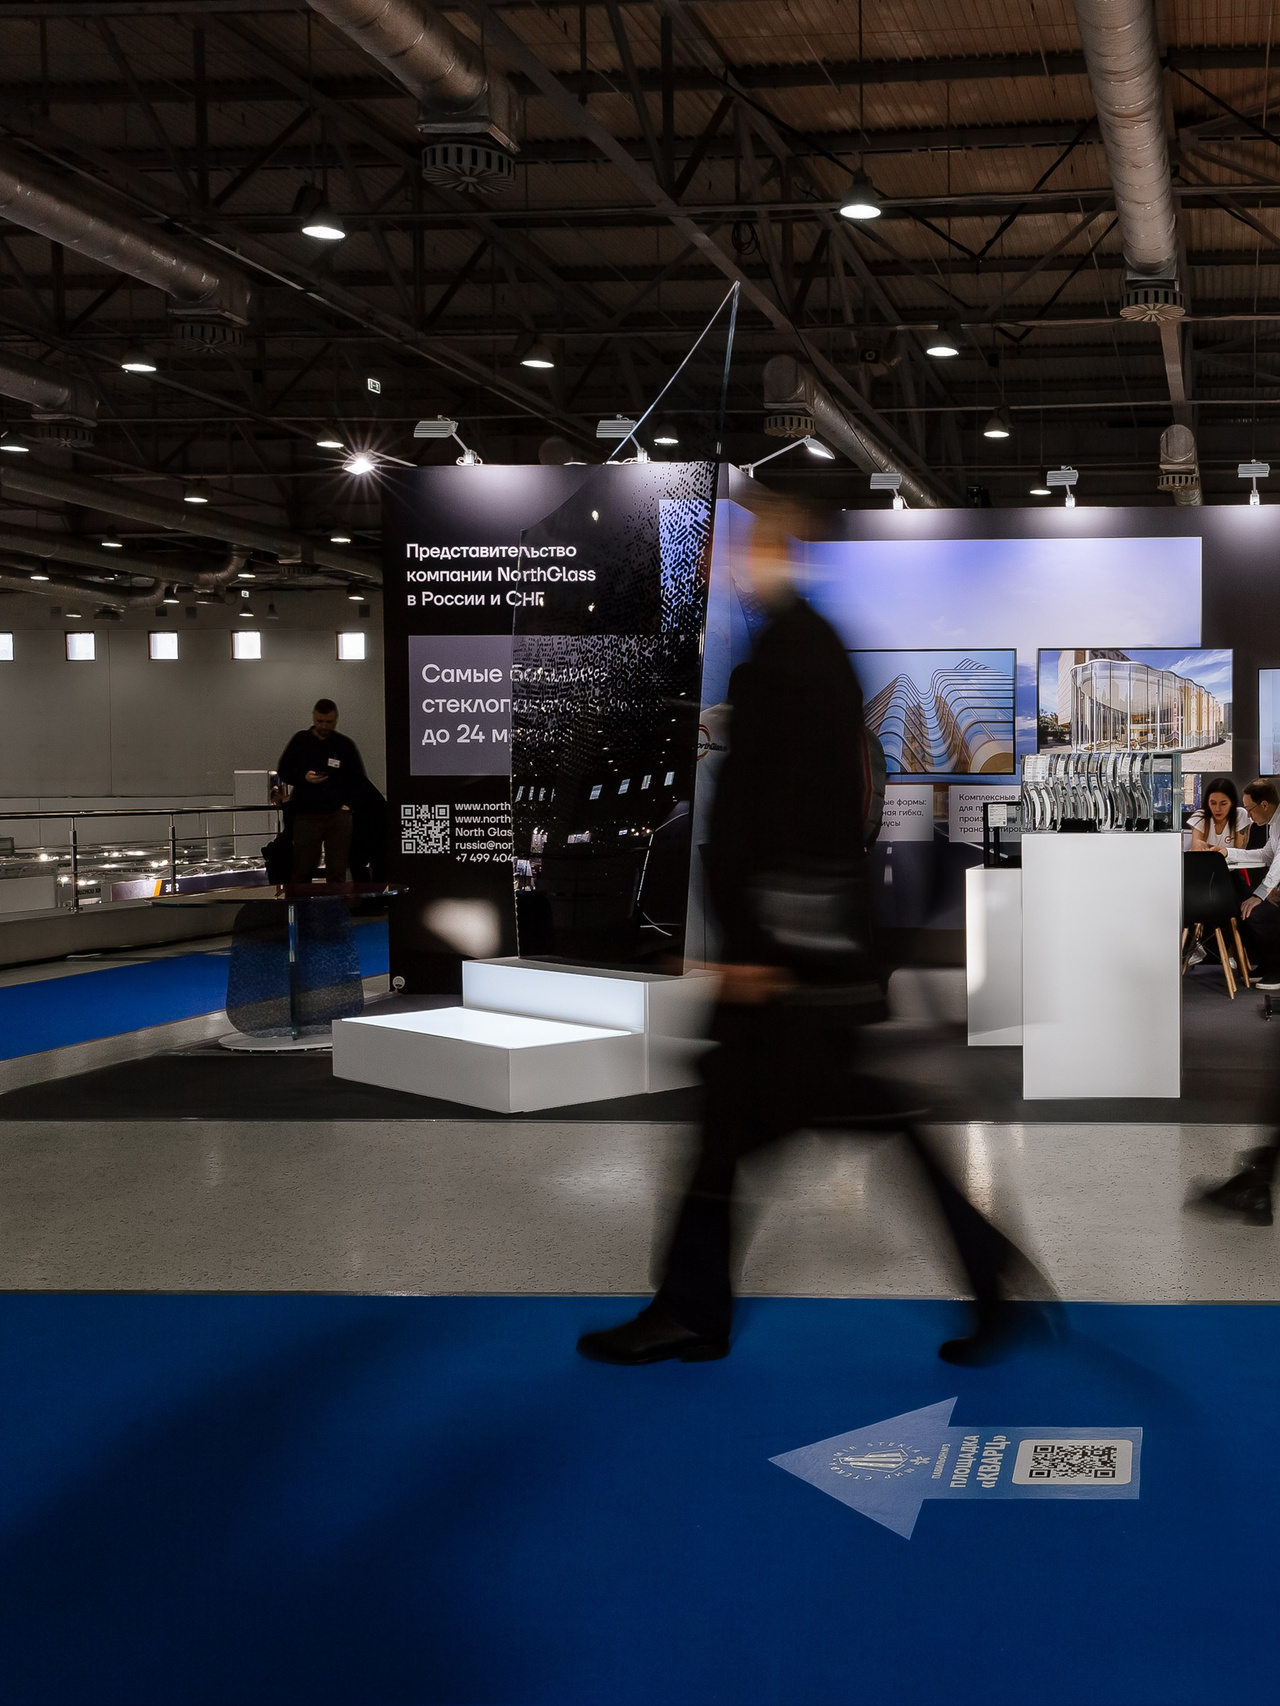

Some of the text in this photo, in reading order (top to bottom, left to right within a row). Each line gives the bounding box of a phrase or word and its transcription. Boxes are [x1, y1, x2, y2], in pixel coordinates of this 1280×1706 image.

[406, 543, 577, 561] Представительство
[406, 566, 597, 582] компании NorthGlass
[407, 590, 545, 607] в России и СНГ
[421, 663, 503, 684] Самые
[421, 728, 450, 746] до
[456, 723, 486, 743] 24
[958, 793, 1016, 801] Комплексные
[454, 801, 511, 811] www.north
[896, 798, 927, 807] формы:
[898, 808, 924, 817] гибка,
[454, 814, 511, 824] www.north
[455, 827, 513, 837] North Glas
[455, 840, 514, 850] russia@nor
[455, 853, 468, 863] +7
[469, 853, 490, 863] 499
[949, 1435, 980, 1488] ПЛОЩАДКА
[976, 1435, 1012, 1488] «КВАРЦ»
